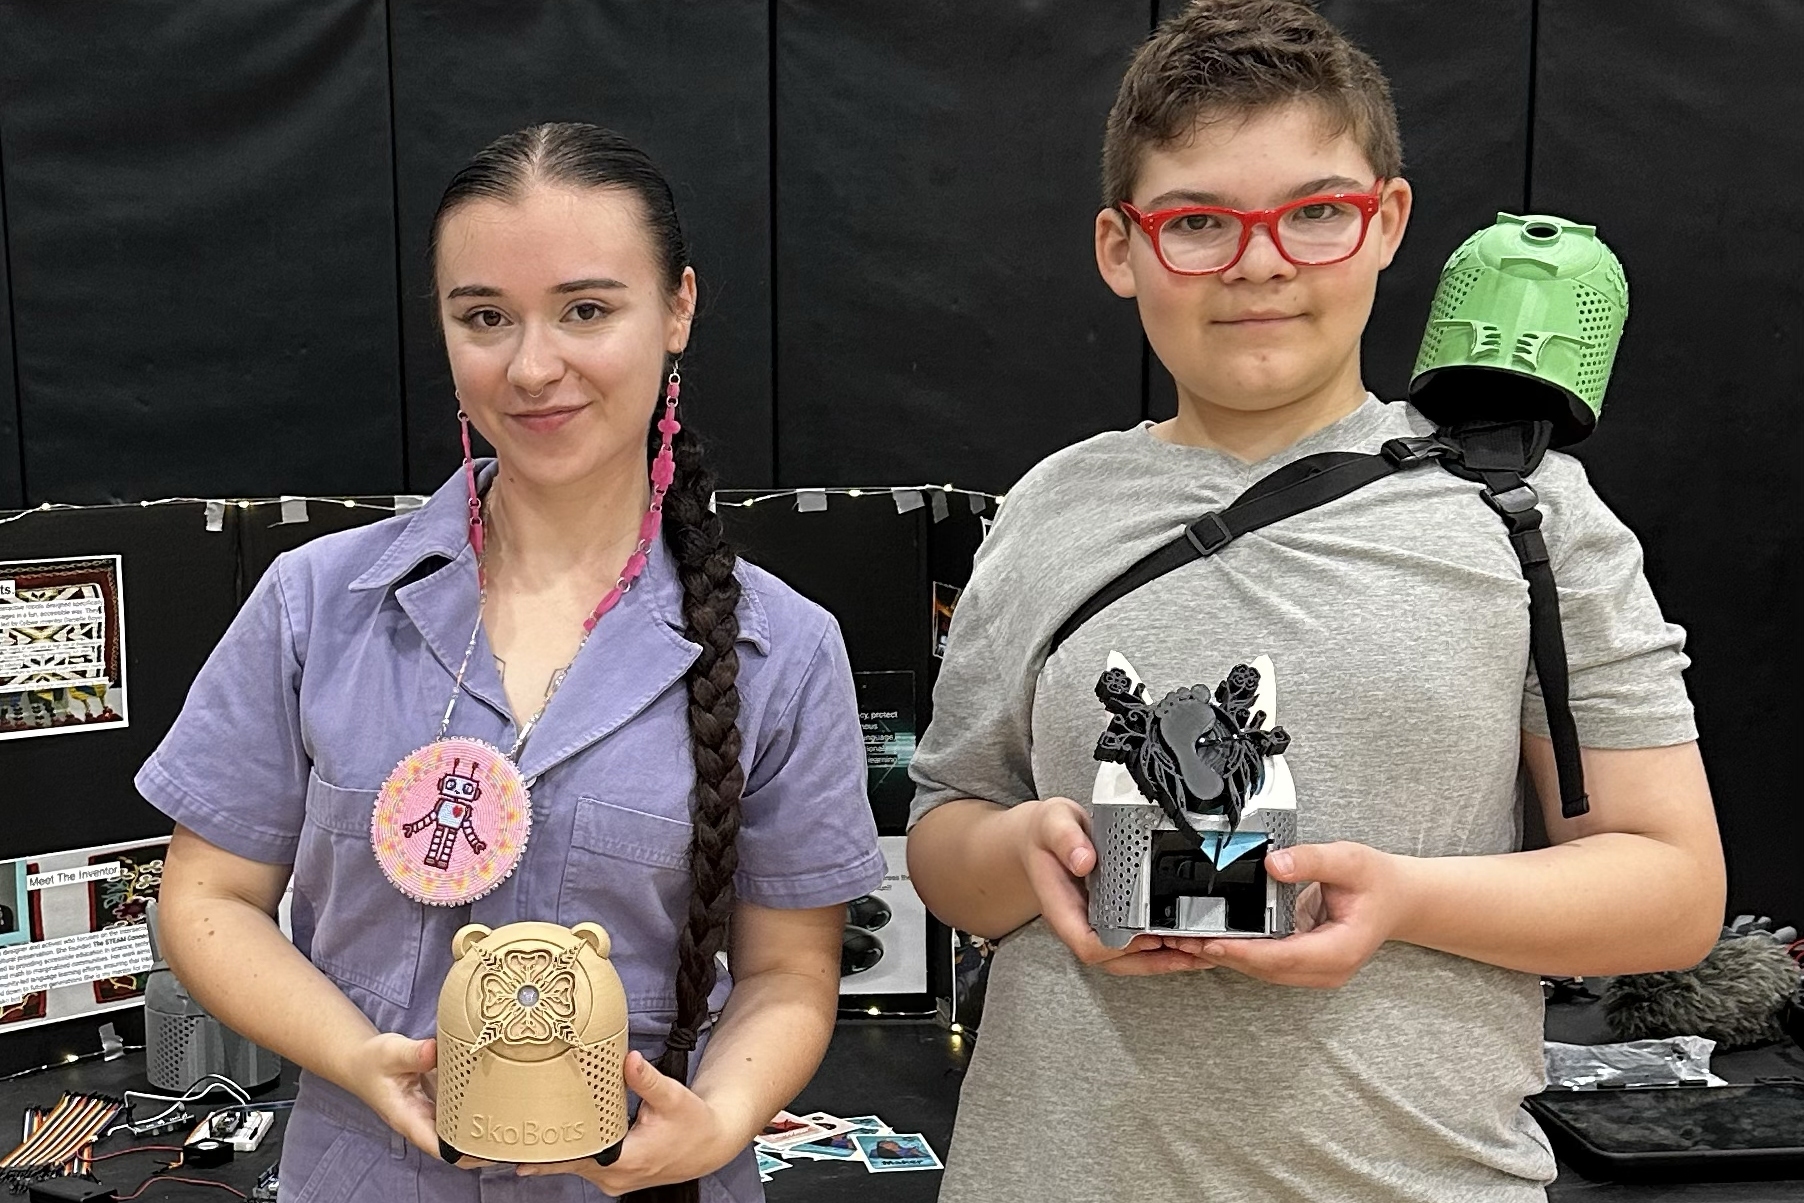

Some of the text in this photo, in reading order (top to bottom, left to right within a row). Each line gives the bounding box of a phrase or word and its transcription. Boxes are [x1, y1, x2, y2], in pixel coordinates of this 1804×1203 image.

[29, 866, 118, 886] Meet The Inventor
[93, 939, 103, 947] The
[105, 935, 126, 945] STEAM
[470, 1113, 585, 1146] SkoBots
